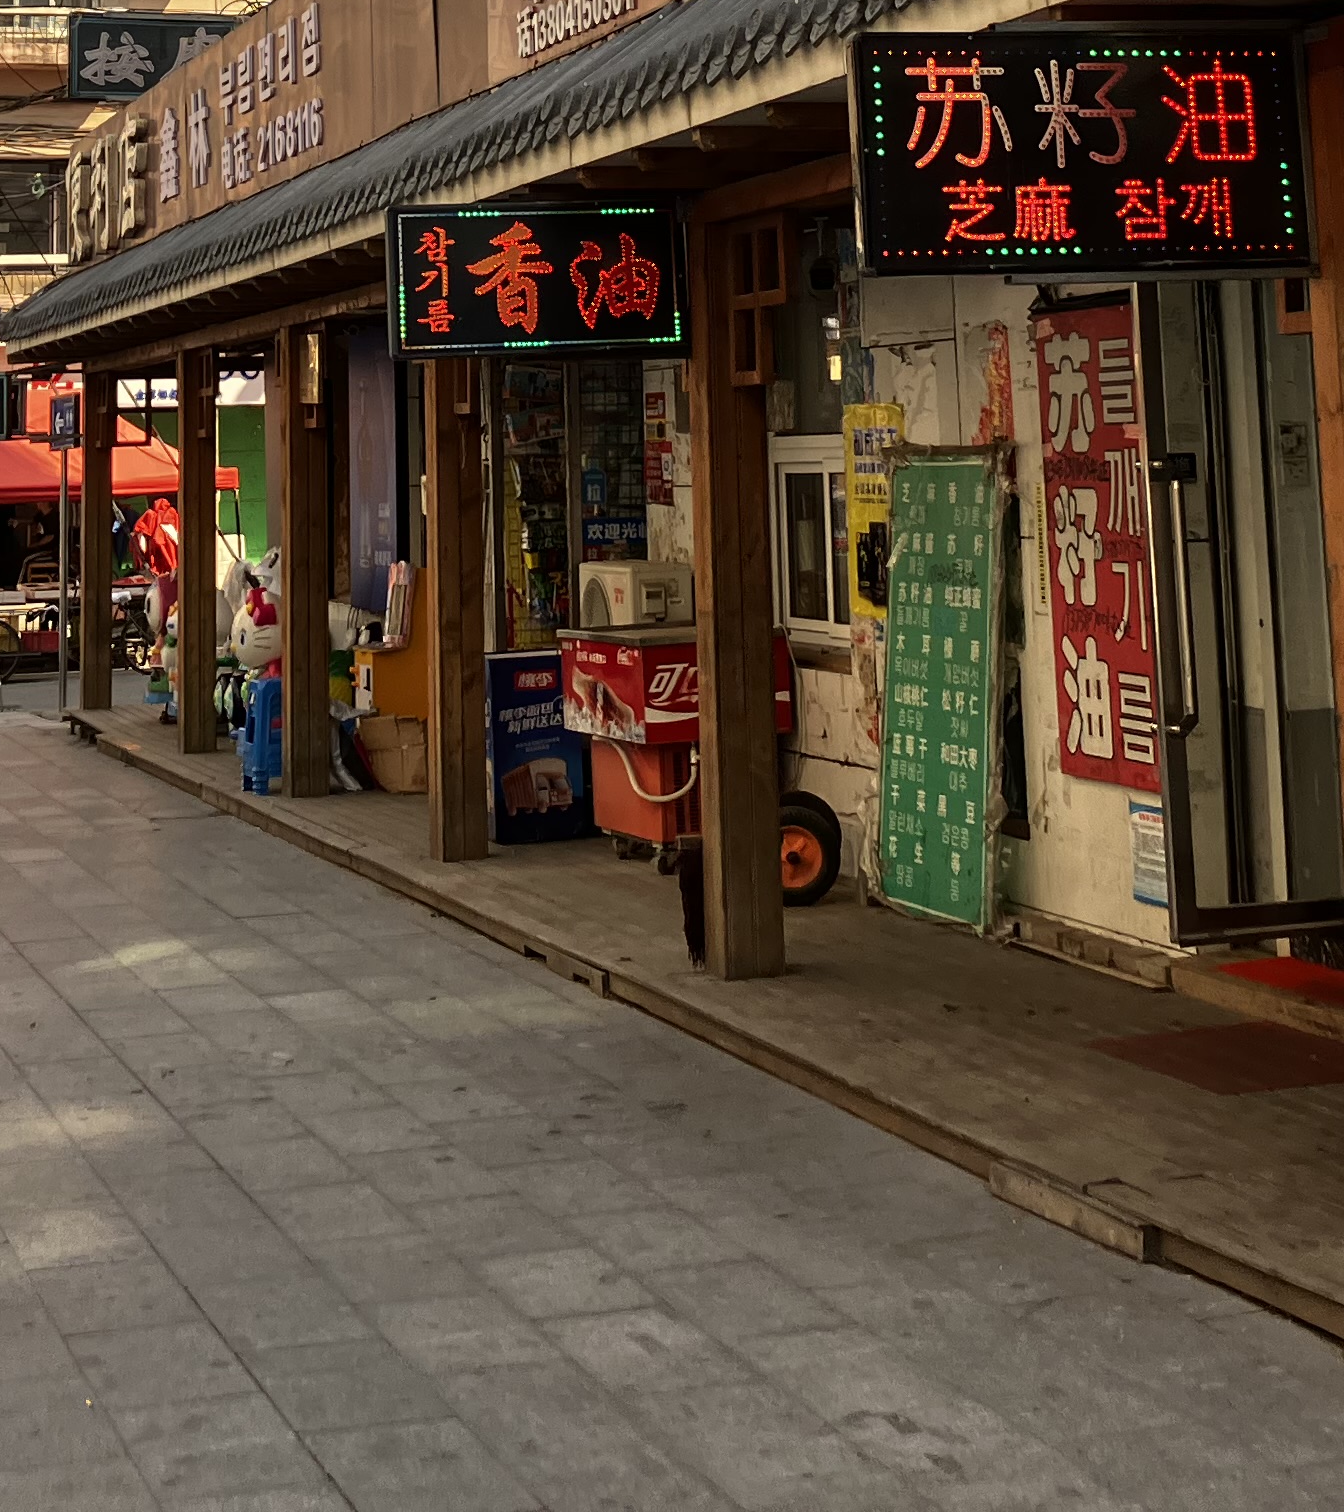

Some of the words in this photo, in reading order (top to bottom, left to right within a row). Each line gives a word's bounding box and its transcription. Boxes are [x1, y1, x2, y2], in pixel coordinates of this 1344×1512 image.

[160, 88, 211, 204] 鑫林
[256, 98, 325, 172] 2168116
[905, 57, 1258, 169] 苏籽油
[943, 176, 1076, 243] 芝麻
[1114, 176, 1234, 240] 참깨
[414, 226, 456, 334] 참기름
[464, 220, 660, 333] 香油
[1043, 333, 1115, 760] 苏籽油
[1098, 336, 1155, 765] 들깨기름
